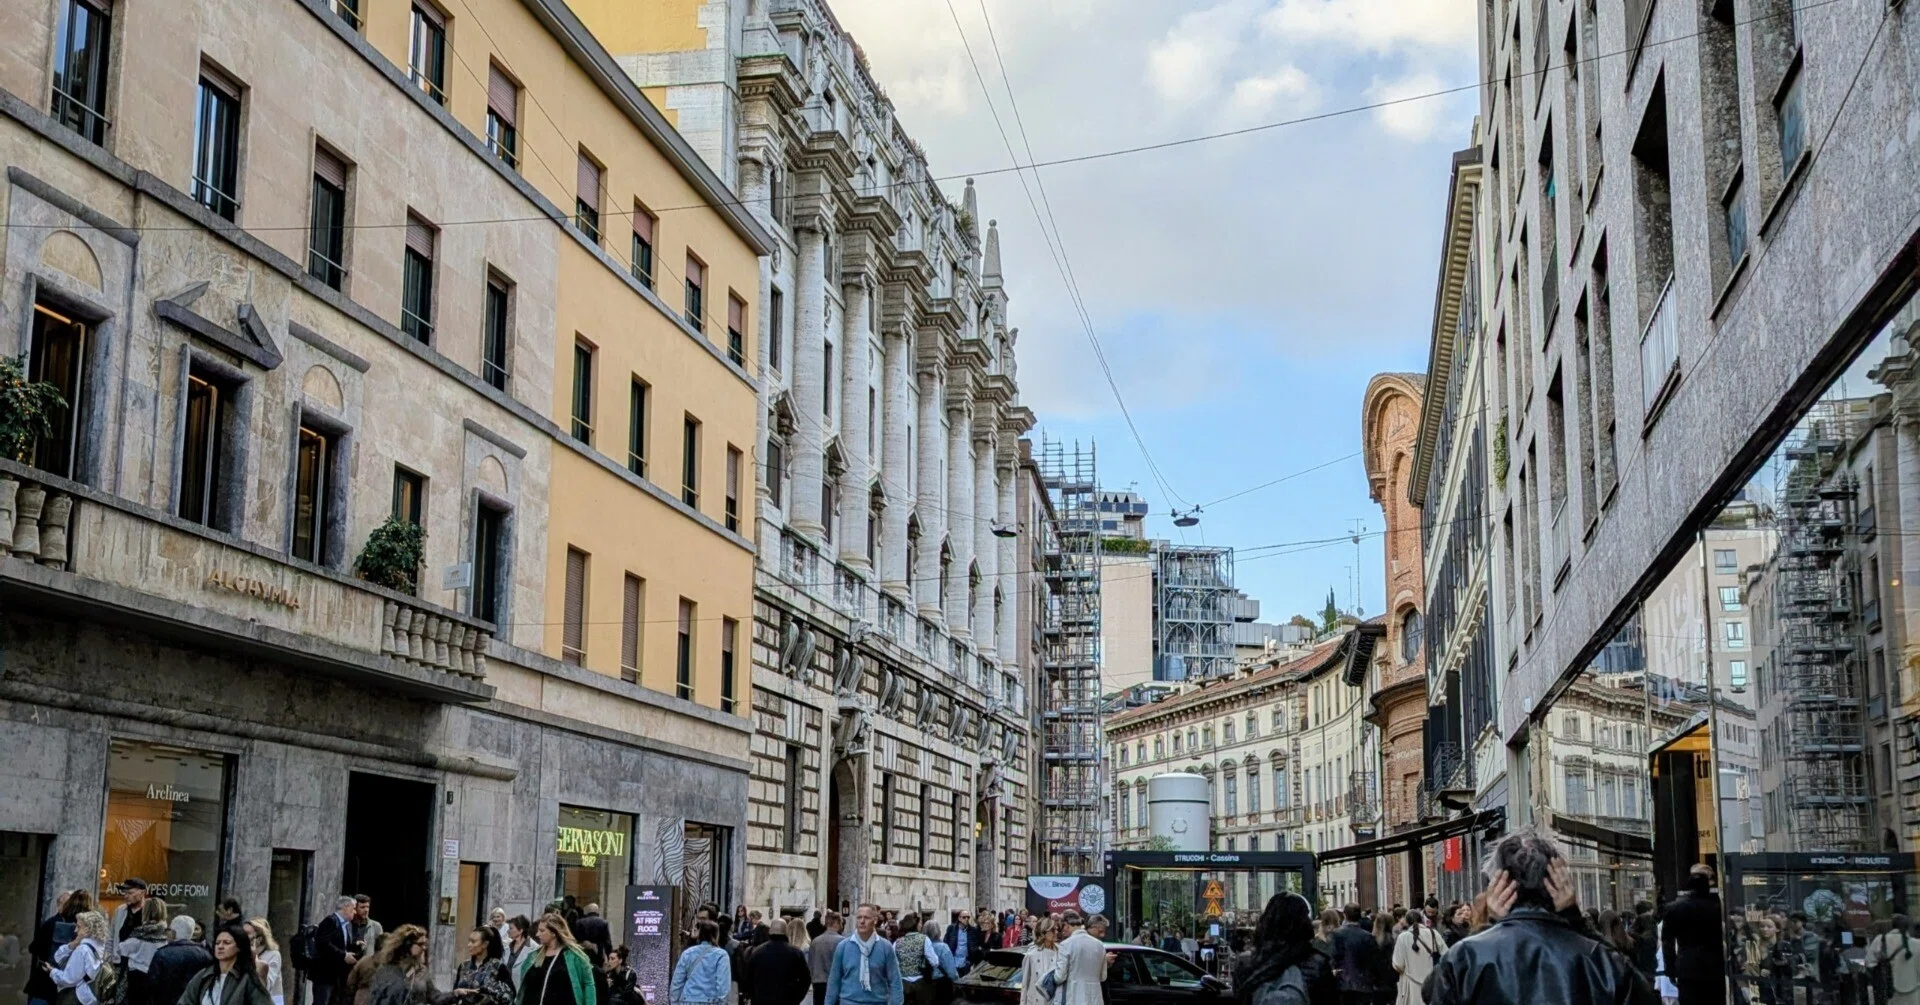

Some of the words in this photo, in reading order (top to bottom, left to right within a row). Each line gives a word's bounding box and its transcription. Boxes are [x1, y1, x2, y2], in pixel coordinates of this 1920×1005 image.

[207, 567, 300, 608] ALCHYMIA
[146, 783, 190, 802] Arclinea
[1210, 854, 1240, 862] Cassina
[169, 884, 182, 896] OF
[184, 884, 209, 897] FORM
[1050, 900, 1077, 908] Quooker
[635, 917, 645, 925] AT
[645, 917, 662, 925] FIRST
[637, 925, 659, 933] FLOOR
